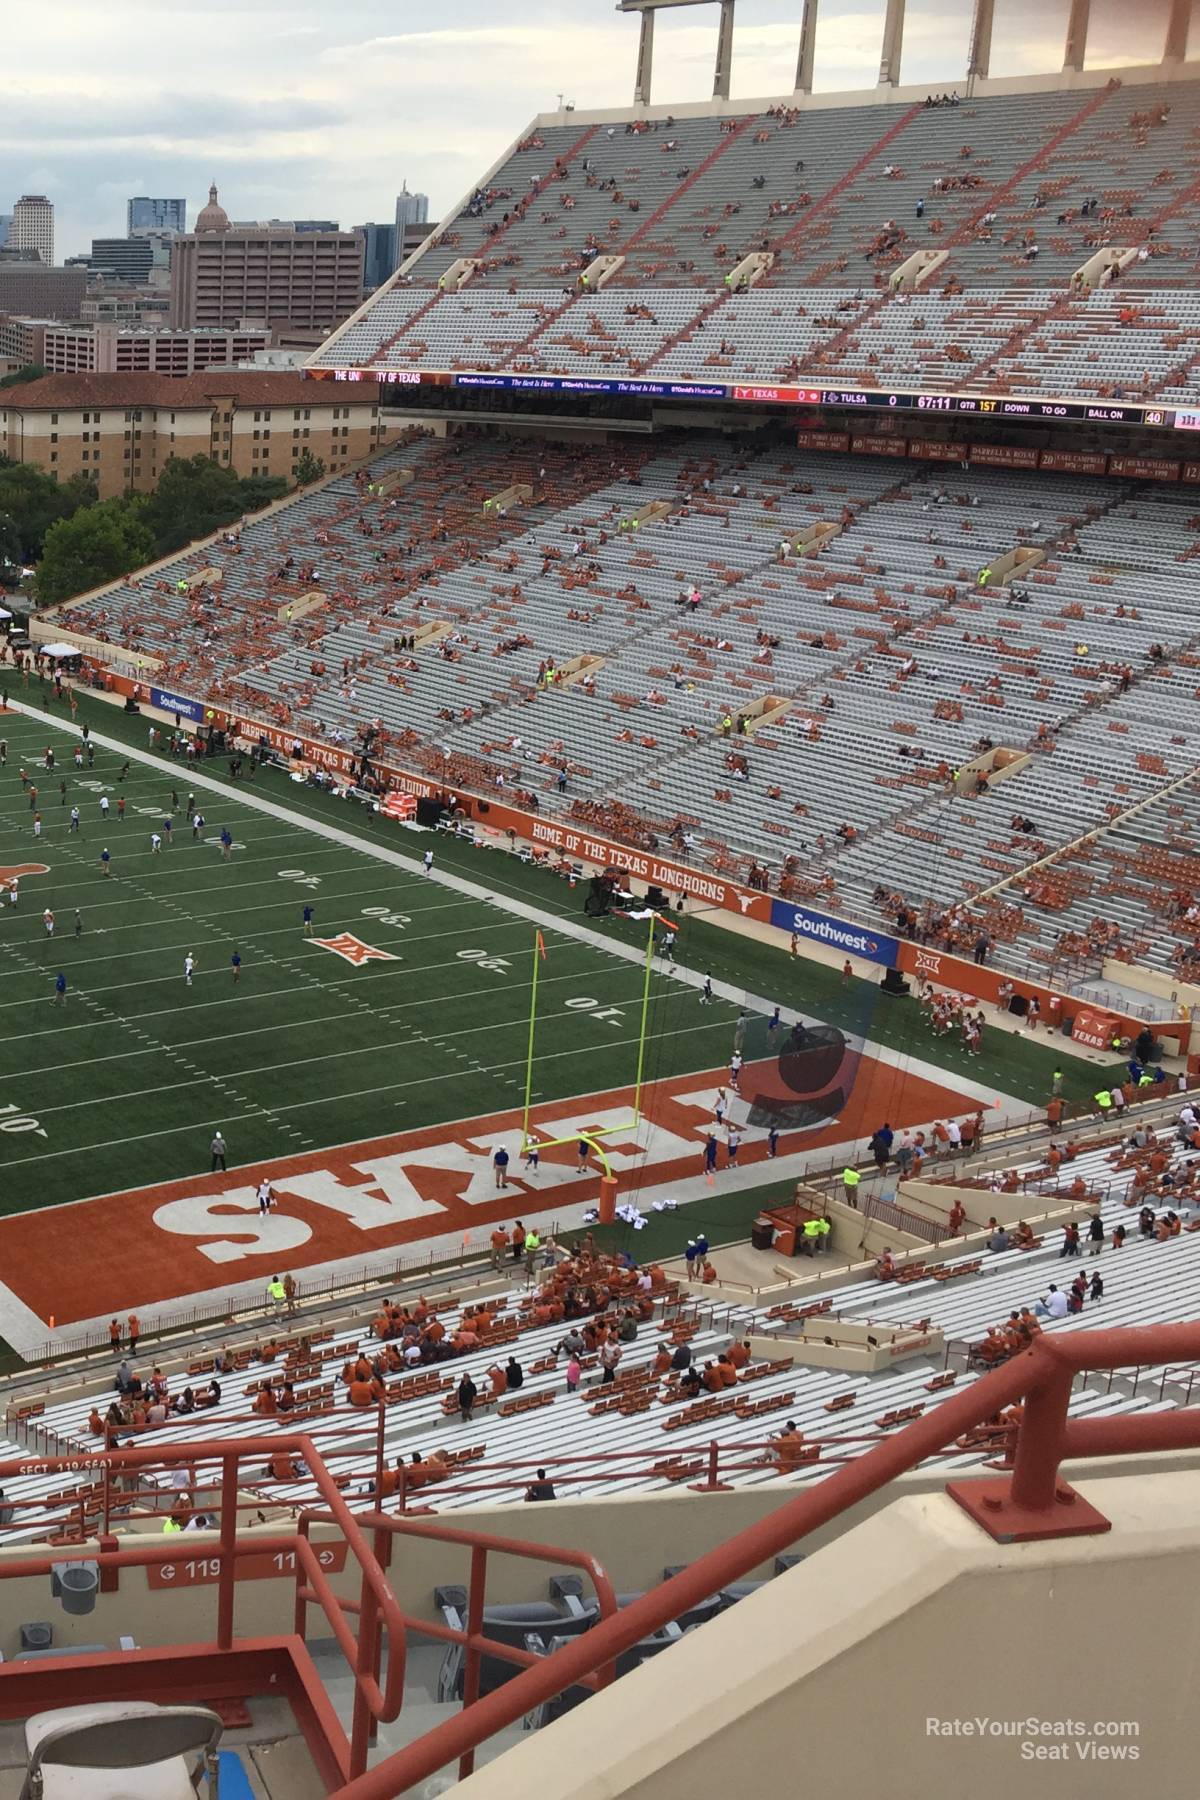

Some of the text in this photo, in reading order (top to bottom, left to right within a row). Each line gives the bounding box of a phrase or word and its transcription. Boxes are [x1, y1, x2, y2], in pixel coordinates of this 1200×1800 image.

[334, 371, 348, 381] THE
[387, 373, 398, 383] OF
[399, 373, 421, 384] TEXAS
[752, 389, 805, 401] TEXAS 0
[840, 393, 897, 406] TULSA 0
[918, 396, 996, 411] 67:11 QTR 1ST
[1004, 403, 1067, 415] DOWN TO GO
[1088, 409, 1161, 423] BALL ON 40
[853, 440, 863, 449] 60
[911, 444, 920, 454] 10
[972, 447, 1003, 457] DARRELL
[1013, 450, 1036, 459] ROYAL
[1041, 454, 1053, 465] 20
[1073, 454, 1105, 465] CAMPBELL
[1110, 460, 1123, 471] 34
[1147, 461, 1179, 471] WILLIAMS
[1186, 466, 1197, 478] 12
[160, 695, 192, 714] Southwest
[276, 734, 282, 747] K
[389, 773, 431, 798] STADIUM
[532, 822, 726, 902] HOME OF THE TEXAS LONGHORNS
[277, 869, 324, 886] 40
[360, 906, 412, 926] 30
[793, 913, 867, 951] Southwest
[455, 949, 513, 970] 20
[564, 997, 627, 1022] 10
[1073, 1029, 1104, 1047] TEXAS
[152, 1087, 841, 1265] TEXAS
[185, 1558, 221, 1579] 119
